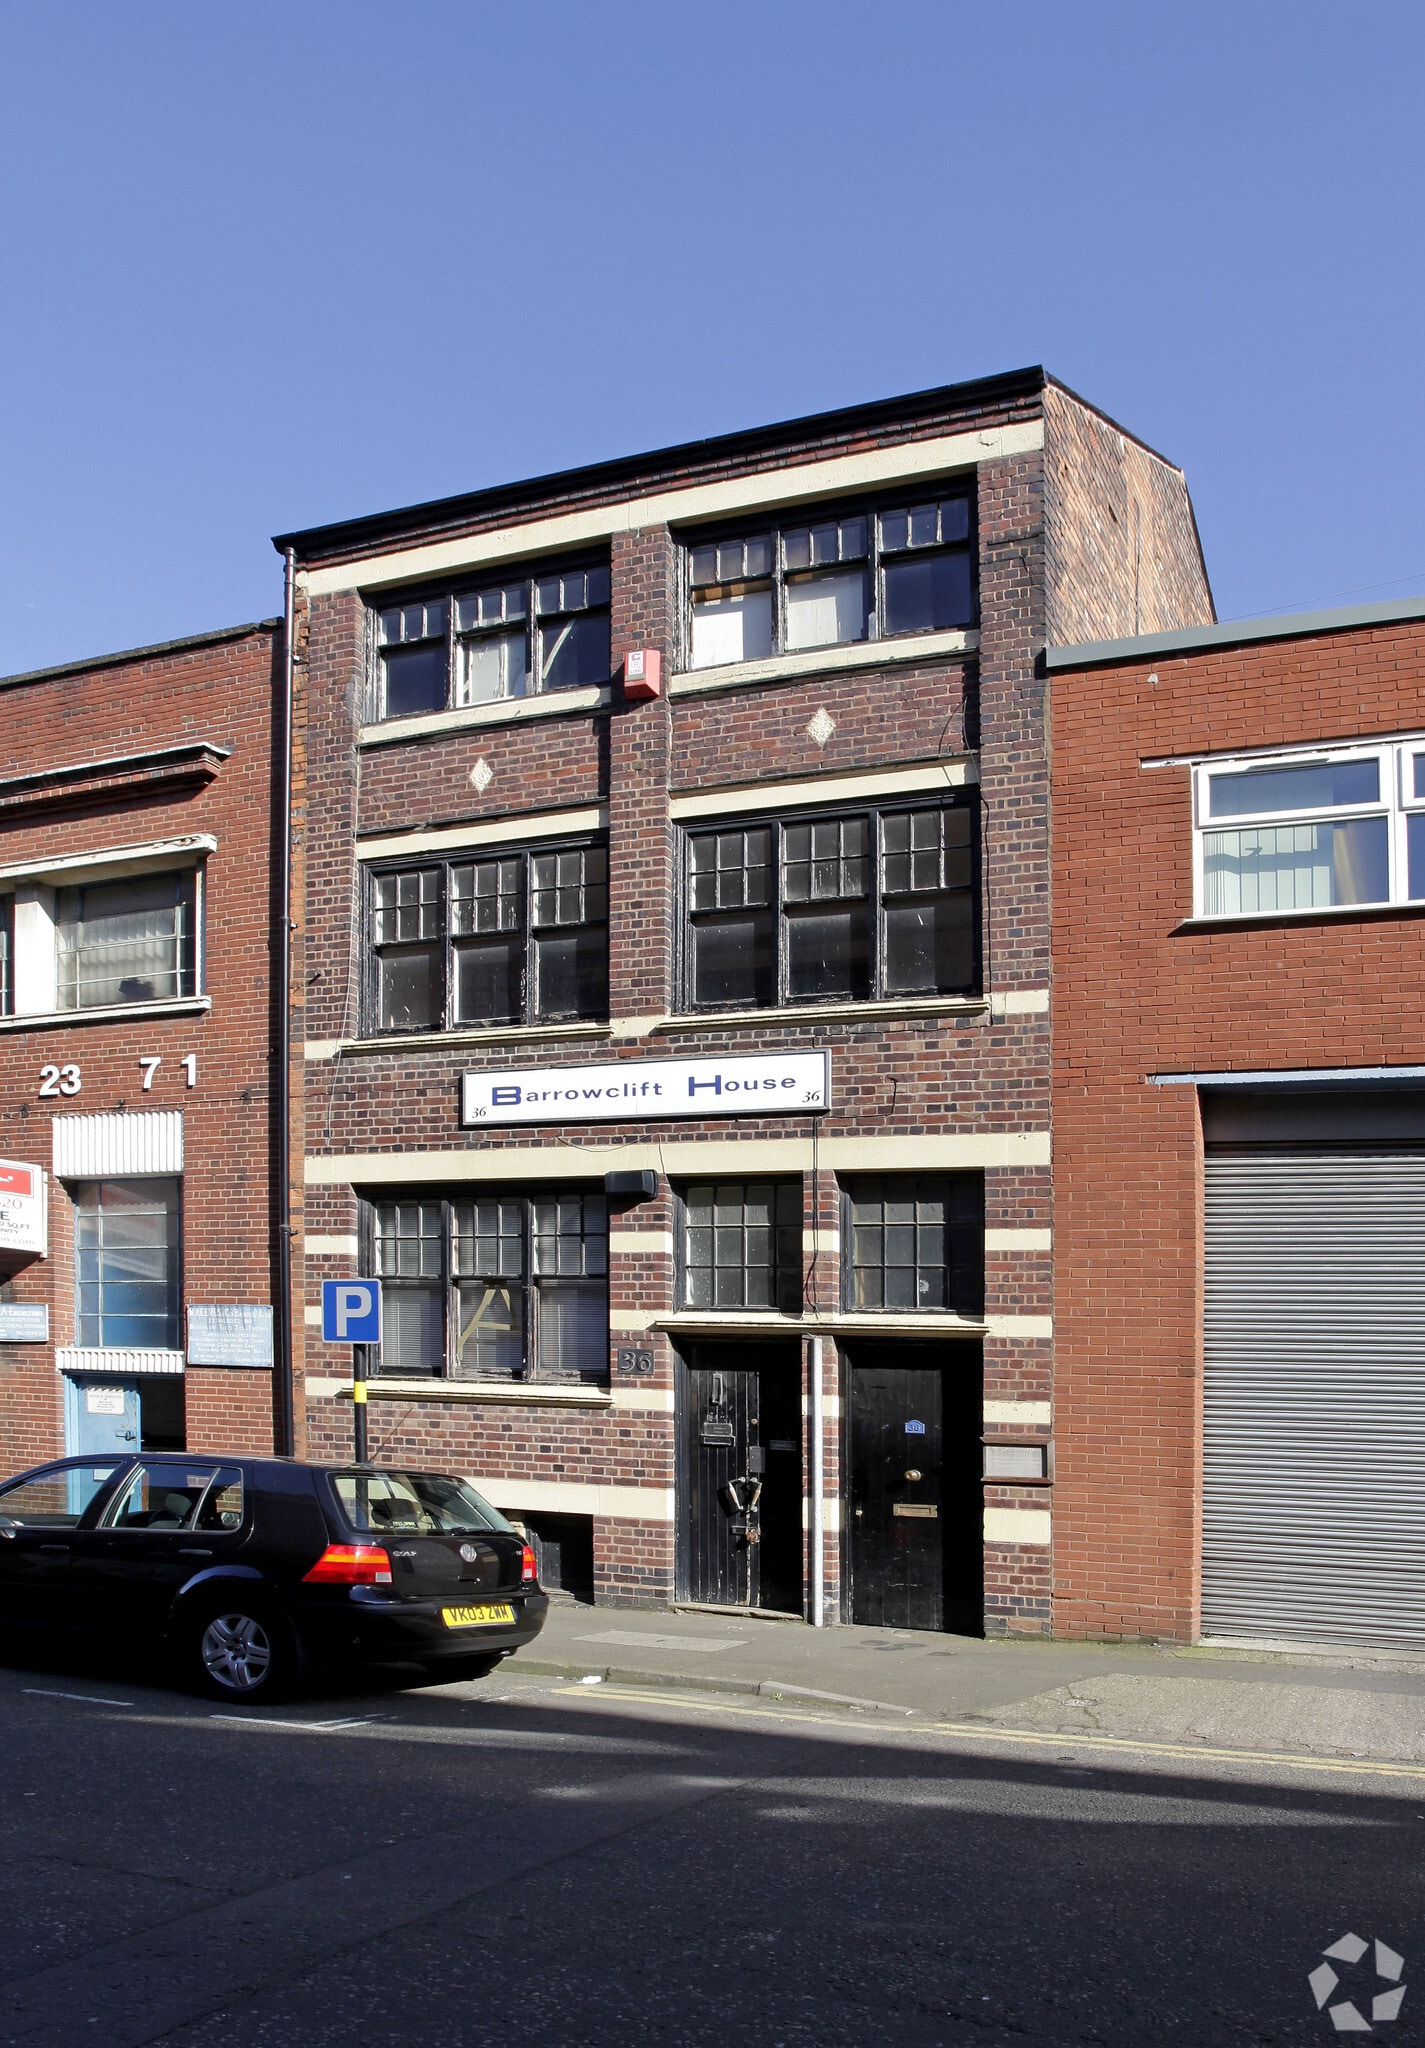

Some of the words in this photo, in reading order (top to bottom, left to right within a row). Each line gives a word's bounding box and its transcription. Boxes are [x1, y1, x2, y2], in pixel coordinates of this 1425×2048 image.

[39, 1064, 82, 1096] 23
[491, 1081, 662, 1107] Barrowclift
[688, 1074, 796, 1097] House
[802, 1090, 821, 1103] 36
[472, 1106, 488, 1118] 36
[336, 1286, 372, 1337] P
[621, 1352, 652, 1371] 36
